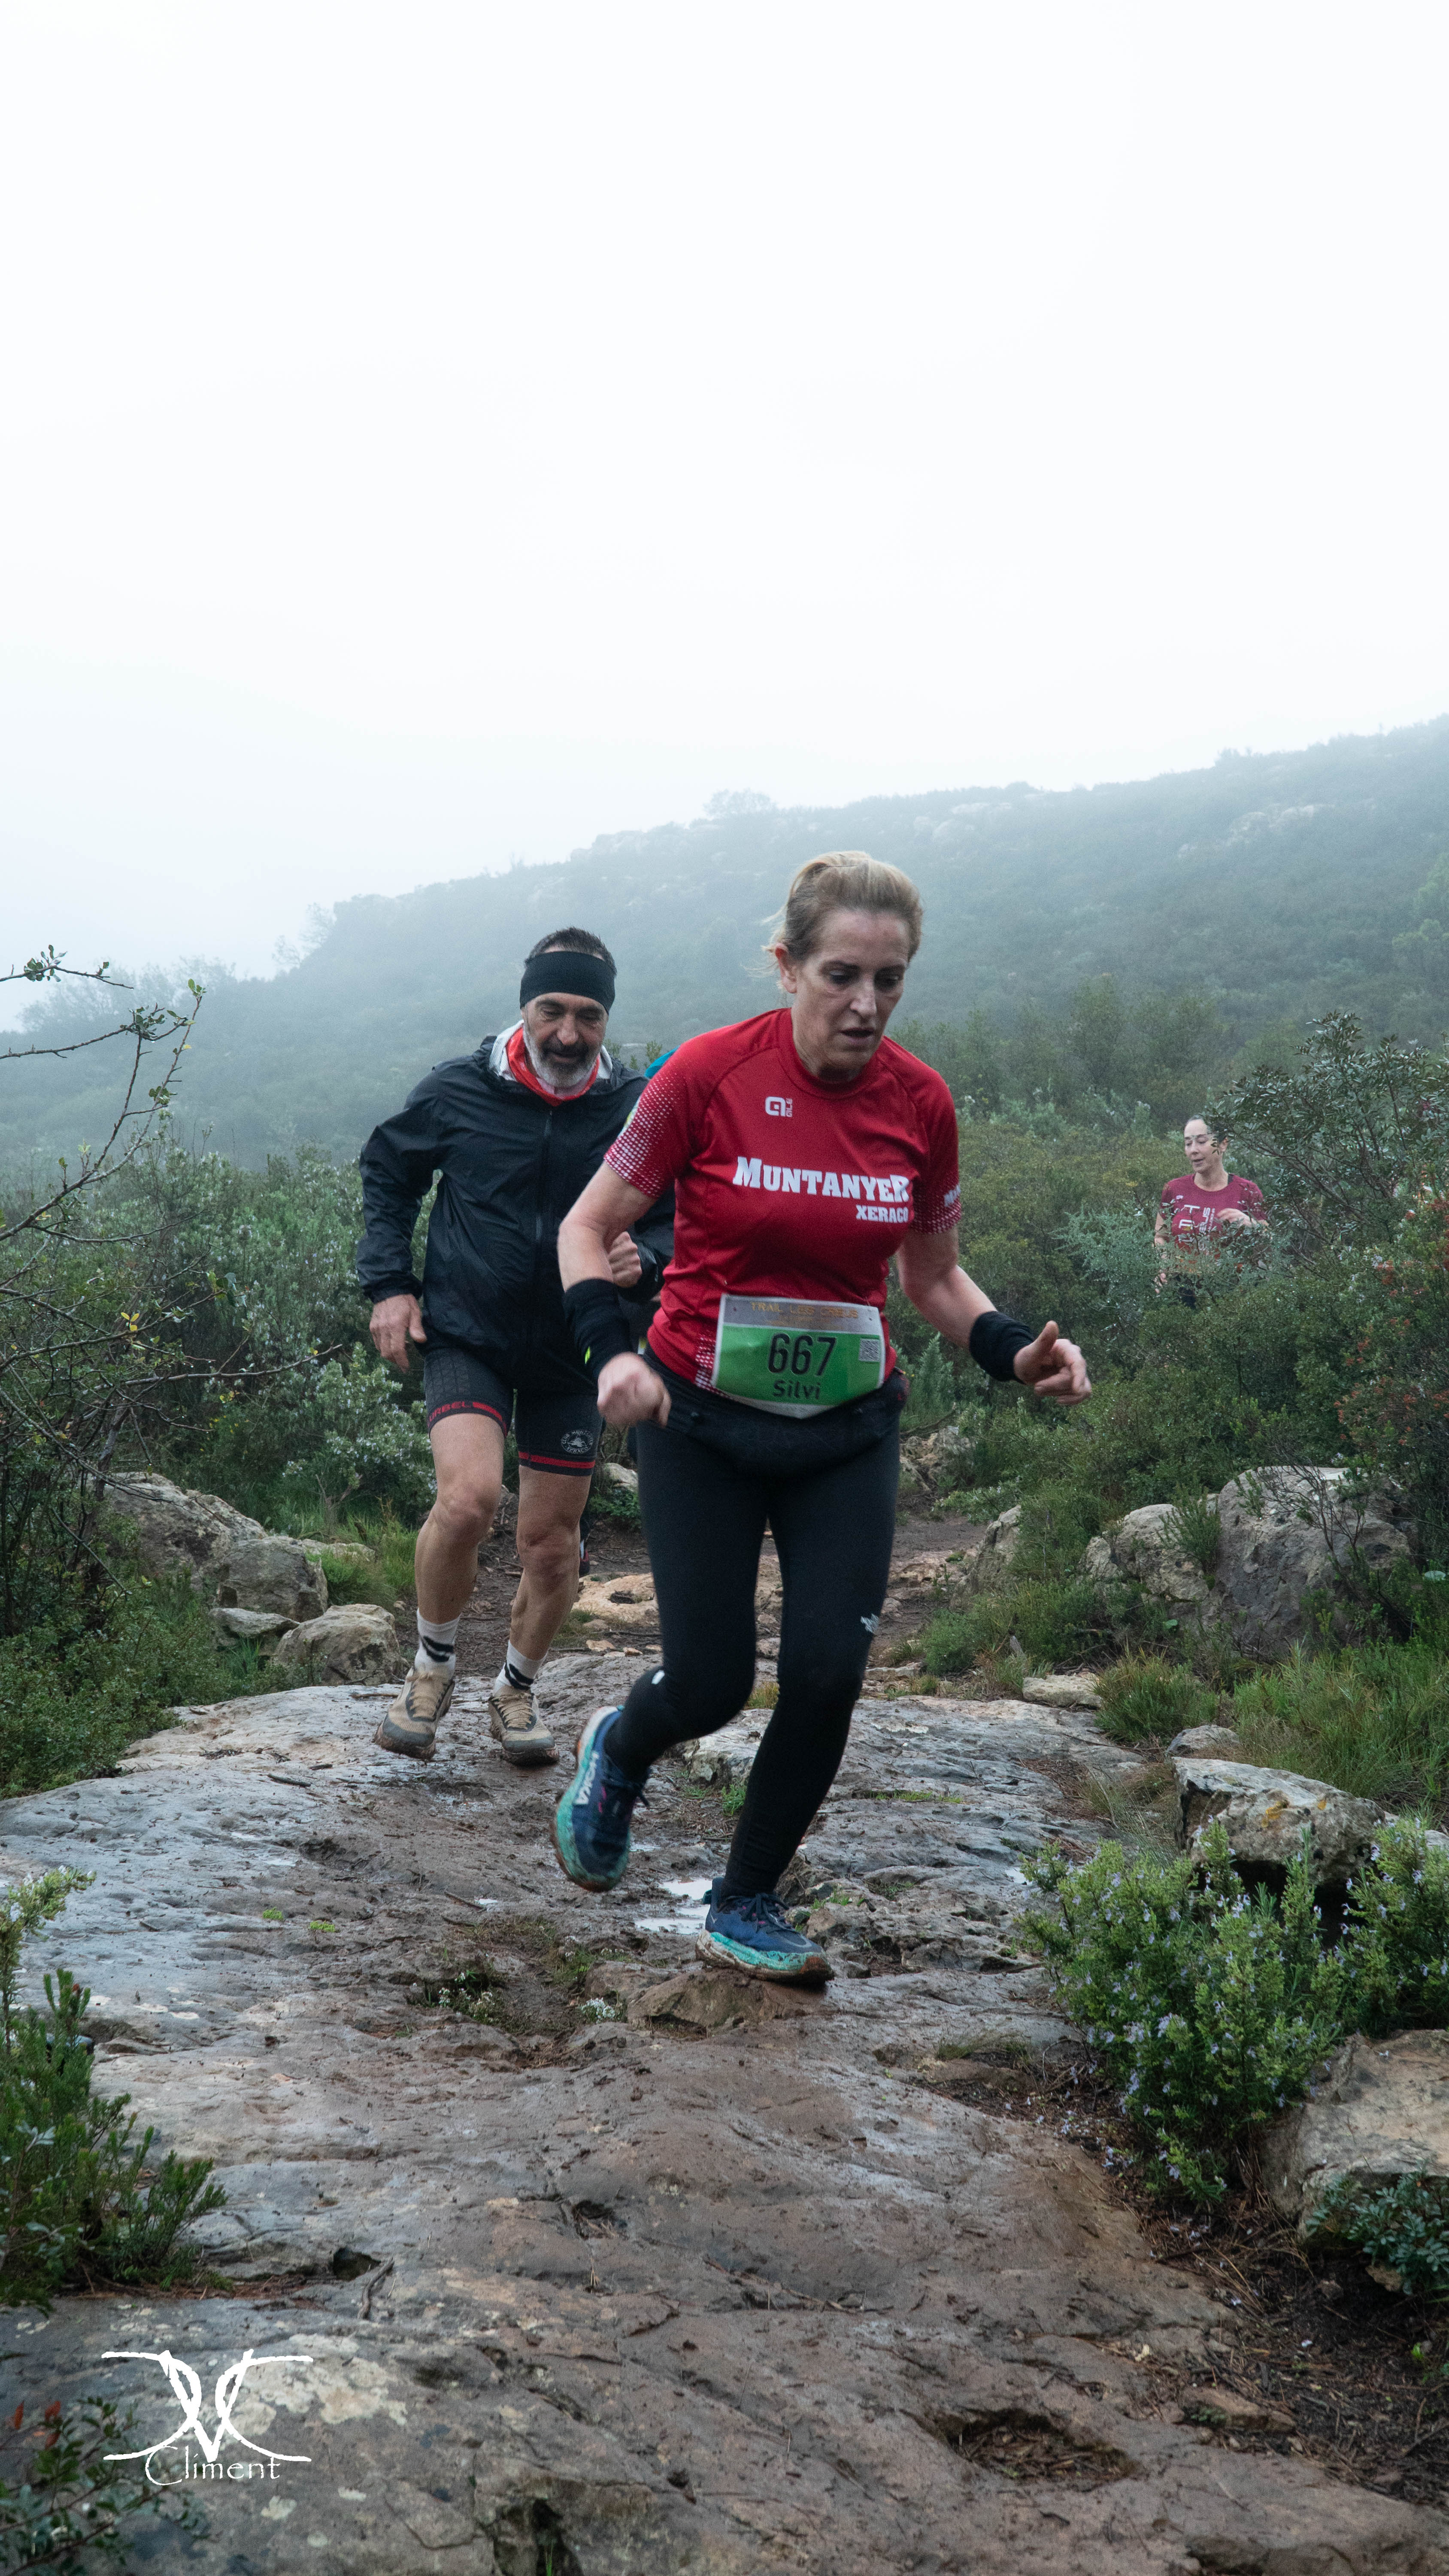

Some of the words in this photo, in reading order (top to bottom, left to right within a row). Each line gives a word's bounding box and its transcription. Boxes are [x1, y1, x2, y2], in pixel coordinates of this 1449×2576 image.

[733, 1156, 909, 1203] MUNTANYER
[856, 1205, 909, 1224] XERACO
[752, 1301, 784, 1312] TRAIL
[790, 1305, 815, 1315] LES
[768, 1333, 836, 1376] 667
[773, 1380, 821, 1400] Silvi
